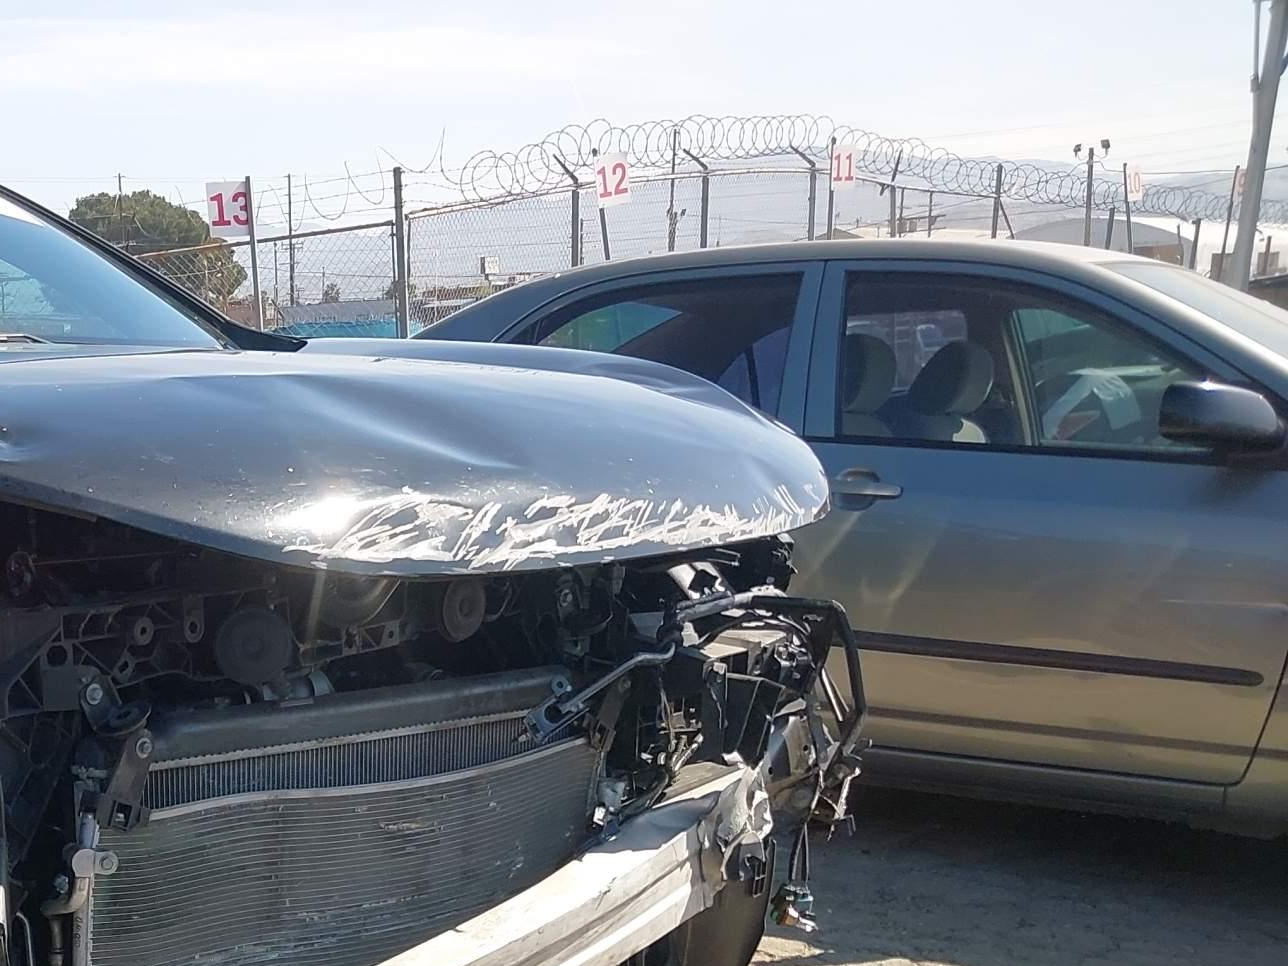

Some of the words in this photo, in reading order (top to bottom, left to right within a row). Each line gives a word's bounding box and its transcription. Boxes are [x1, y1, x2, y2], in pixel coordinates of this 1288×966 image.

[597, 162, 629, 198] 12
[833, 153, 854, 181] 11
[1128, 172, 1141, 194] 10
[209, 191, 249, 227] 13
